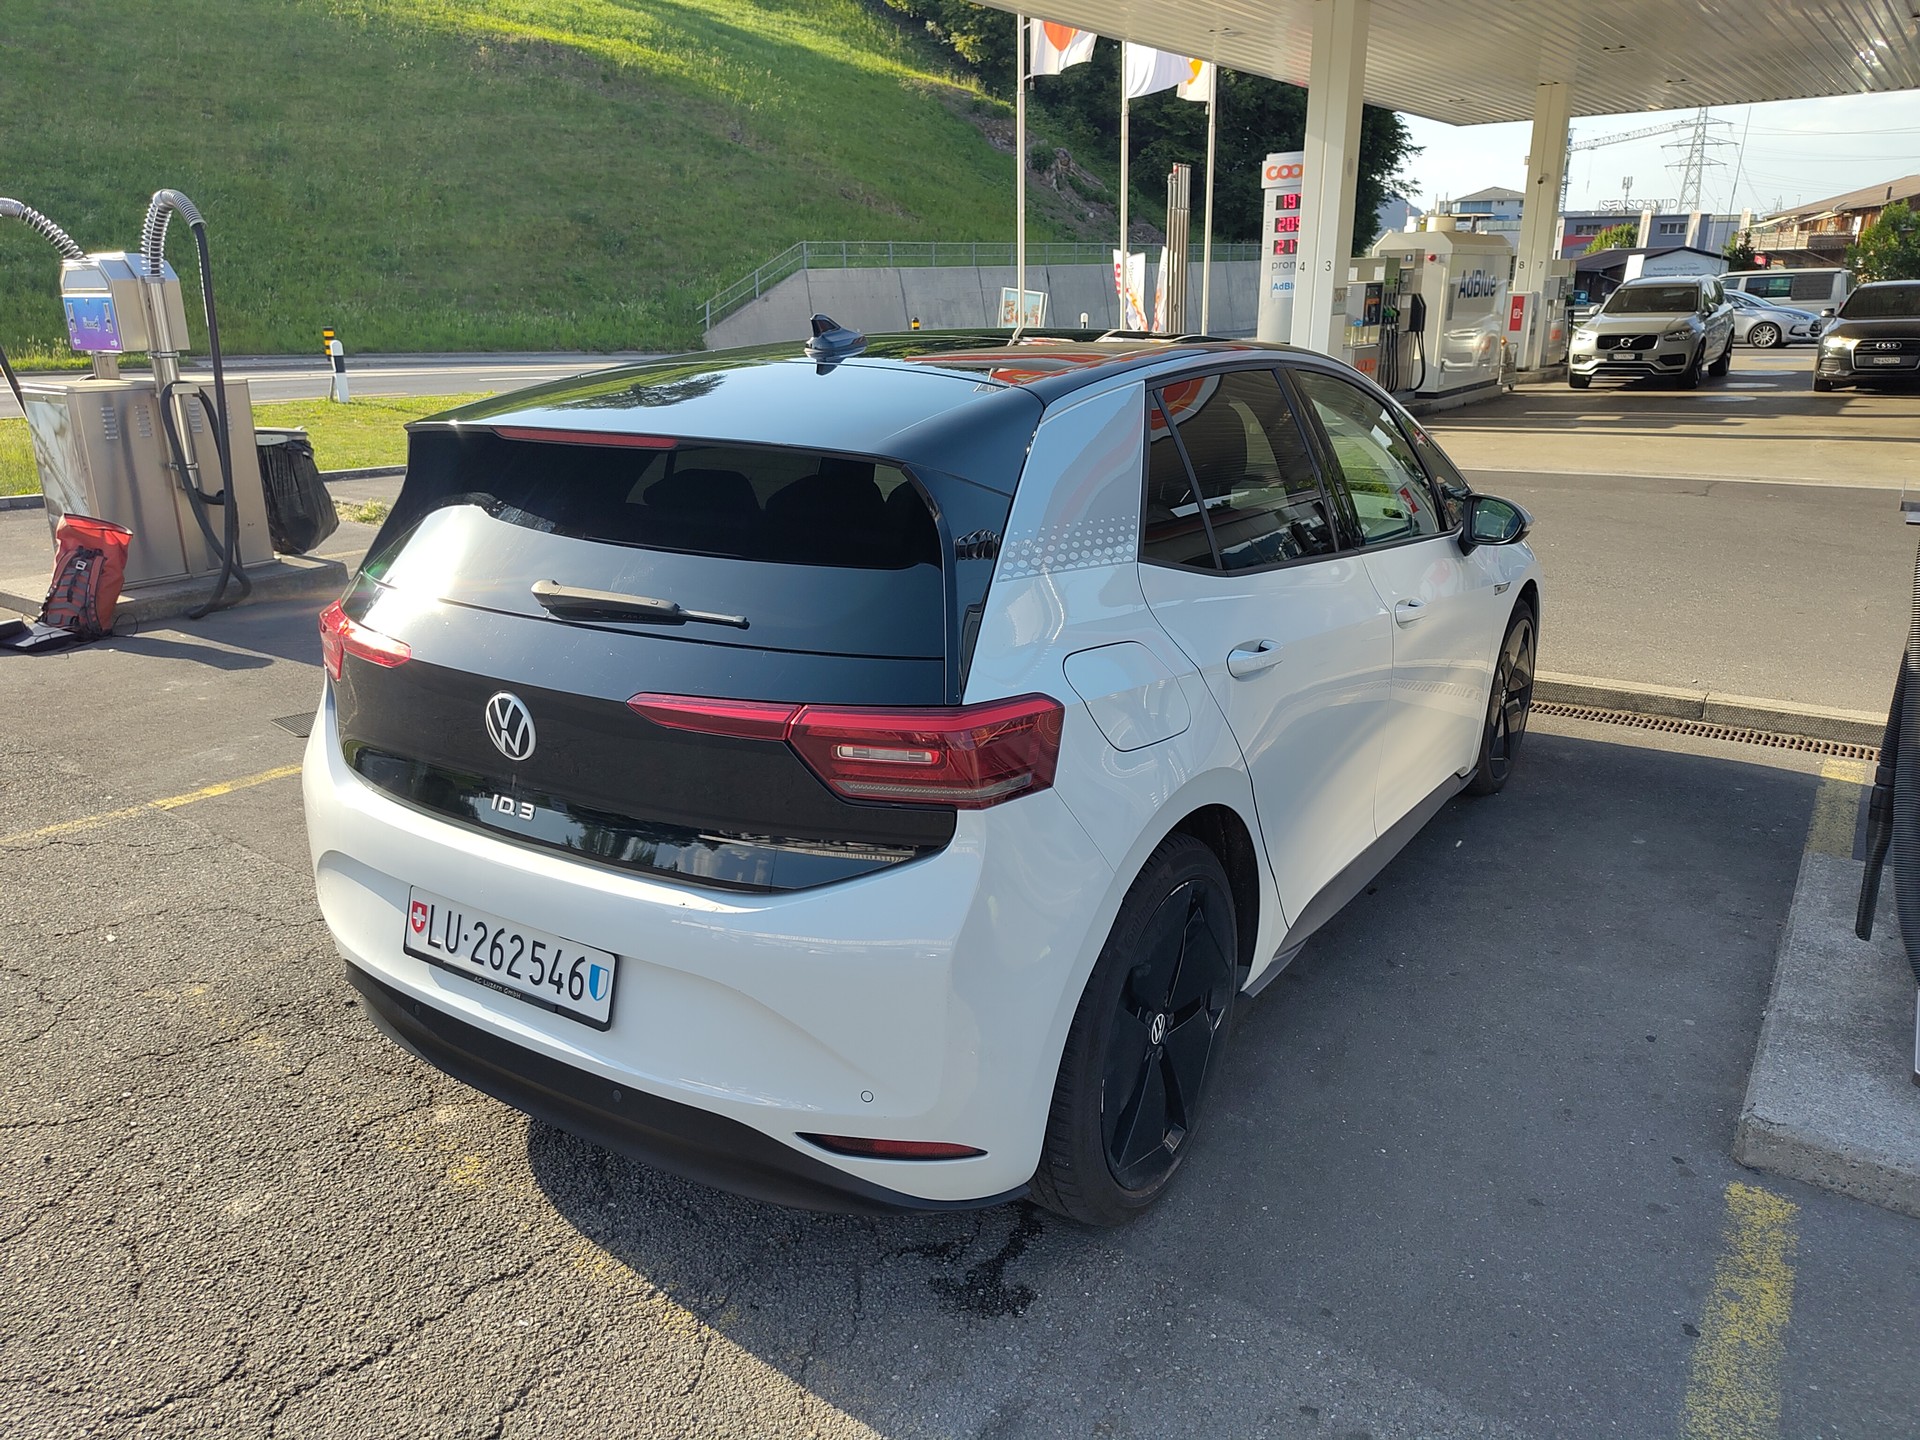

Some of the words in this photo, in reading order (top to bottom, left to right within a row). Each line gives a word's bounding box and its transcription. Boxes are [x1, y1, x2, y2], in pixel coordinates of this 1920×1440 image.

[1265, 164, 1304, 181] coo
[1283, 193, 1302, 209] 19
[1275, 239, 1300, 254] 21
[1271, 261, 1296, 271] pron
[1299, 261, 1306, 272] 4
[1325, 261, 1332, 272] 3
[1518, 261, 1525, 270] 8
[1538, 261, 1544, 269] 7
[1272, 282, 1295, 291] AdBl
[1457, 269, 1497, 299] AdBlue
[483, 979, 503, 992] Luzern
[503, 987, 522, 999] GmbH
